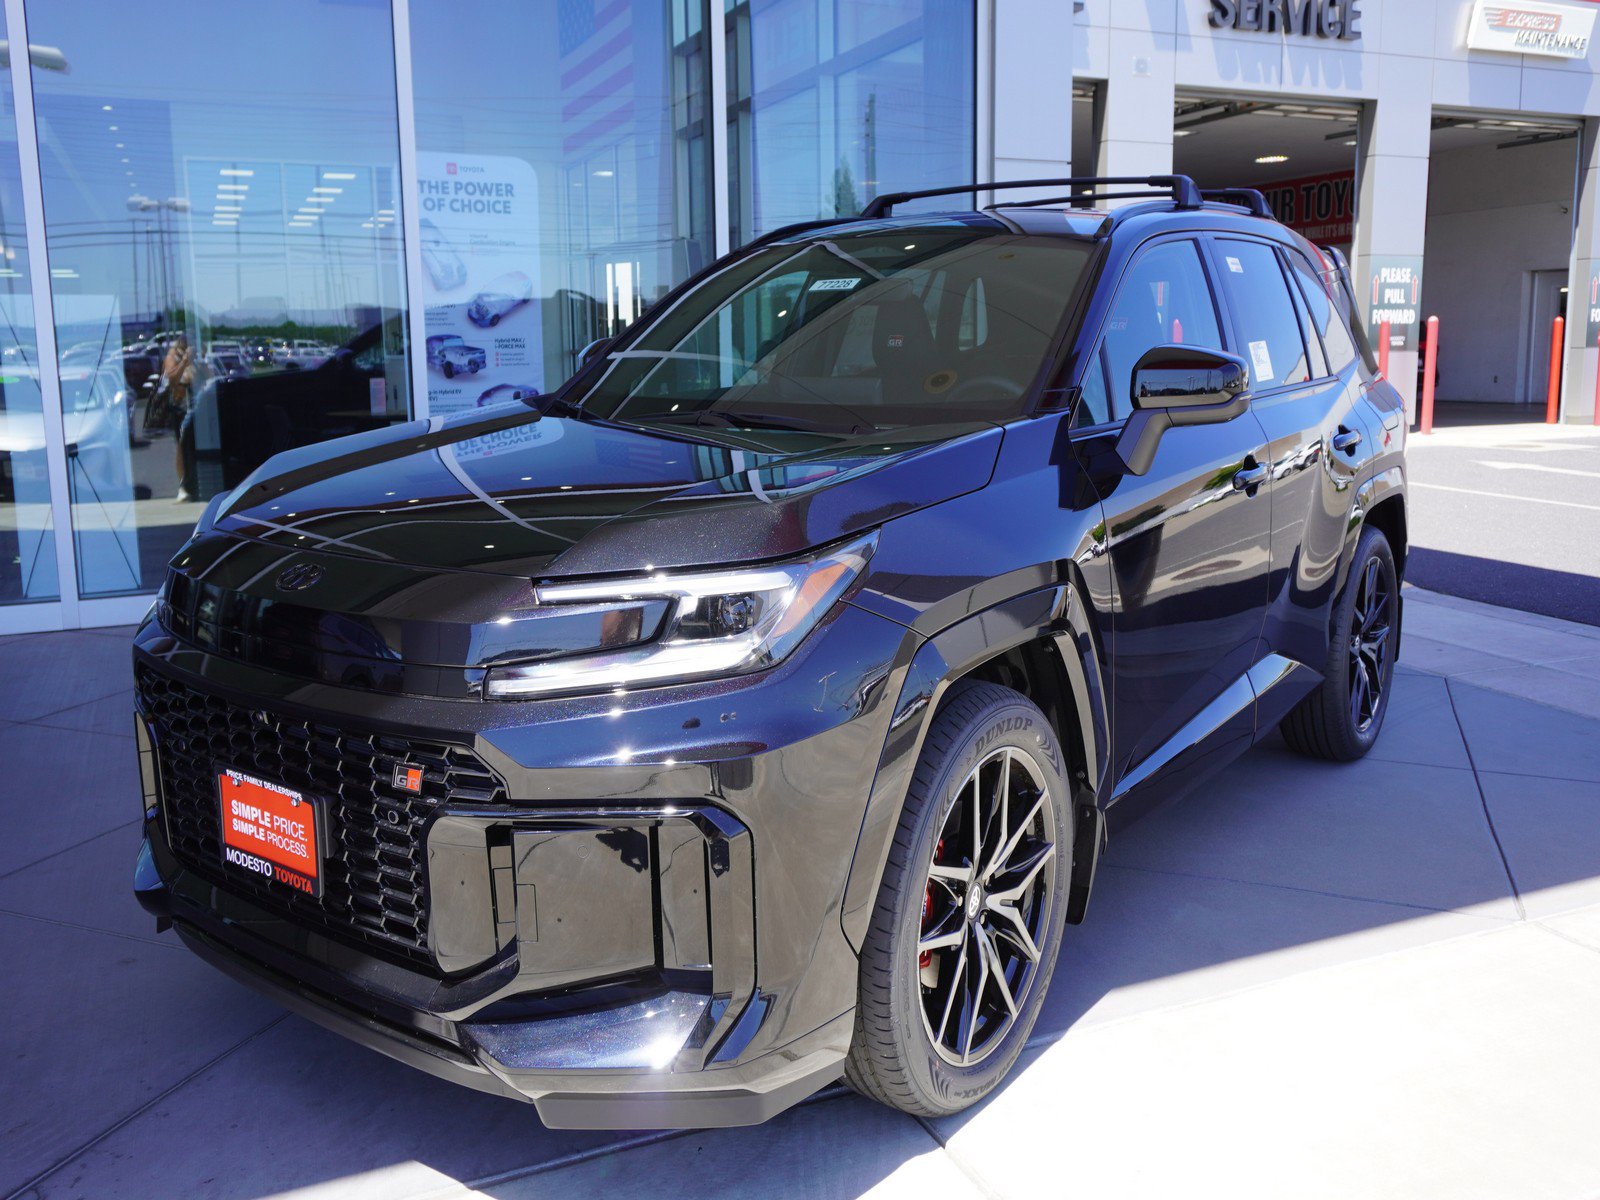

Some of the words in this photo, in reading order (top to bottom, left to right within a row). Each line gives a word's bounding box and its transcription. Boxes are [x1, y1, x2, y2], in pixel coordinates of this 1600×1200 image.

[1208, 0, 1361, 40] SERVICE
[1505, 12, 1557, 30] EXPRESS
[1515, 30, 1587, 50] MAINTENANCE
[417, 179, 449, 194] THE
[454, 181, 515, 198] POWER
[423, 197, 446, 211] OF
[449, 199, 511, 214] CHOICE
[1381, 267, 1411, 283] PLEASE
[1384, 288, 1405, 304] PULL
[975, 717, 1033, 757] DUNLOP
[226, 769, 243, 782] PRICE
[243, 775, 263, 788] FAMILY
[263, 781, 302, 801] DEALERSHIPS
[397, 775, 419, 791] GR
[231, 799, 271, 828] SIMPLE
[273, 815, 308, 842] PRICE.
[232, 818, 265, 841] SIMPLE
[267, 831, 309, 859] PROCESS.
[226, 847, 272, 877] MODESTO
[274, 866, 313, 895] TOYOTA
